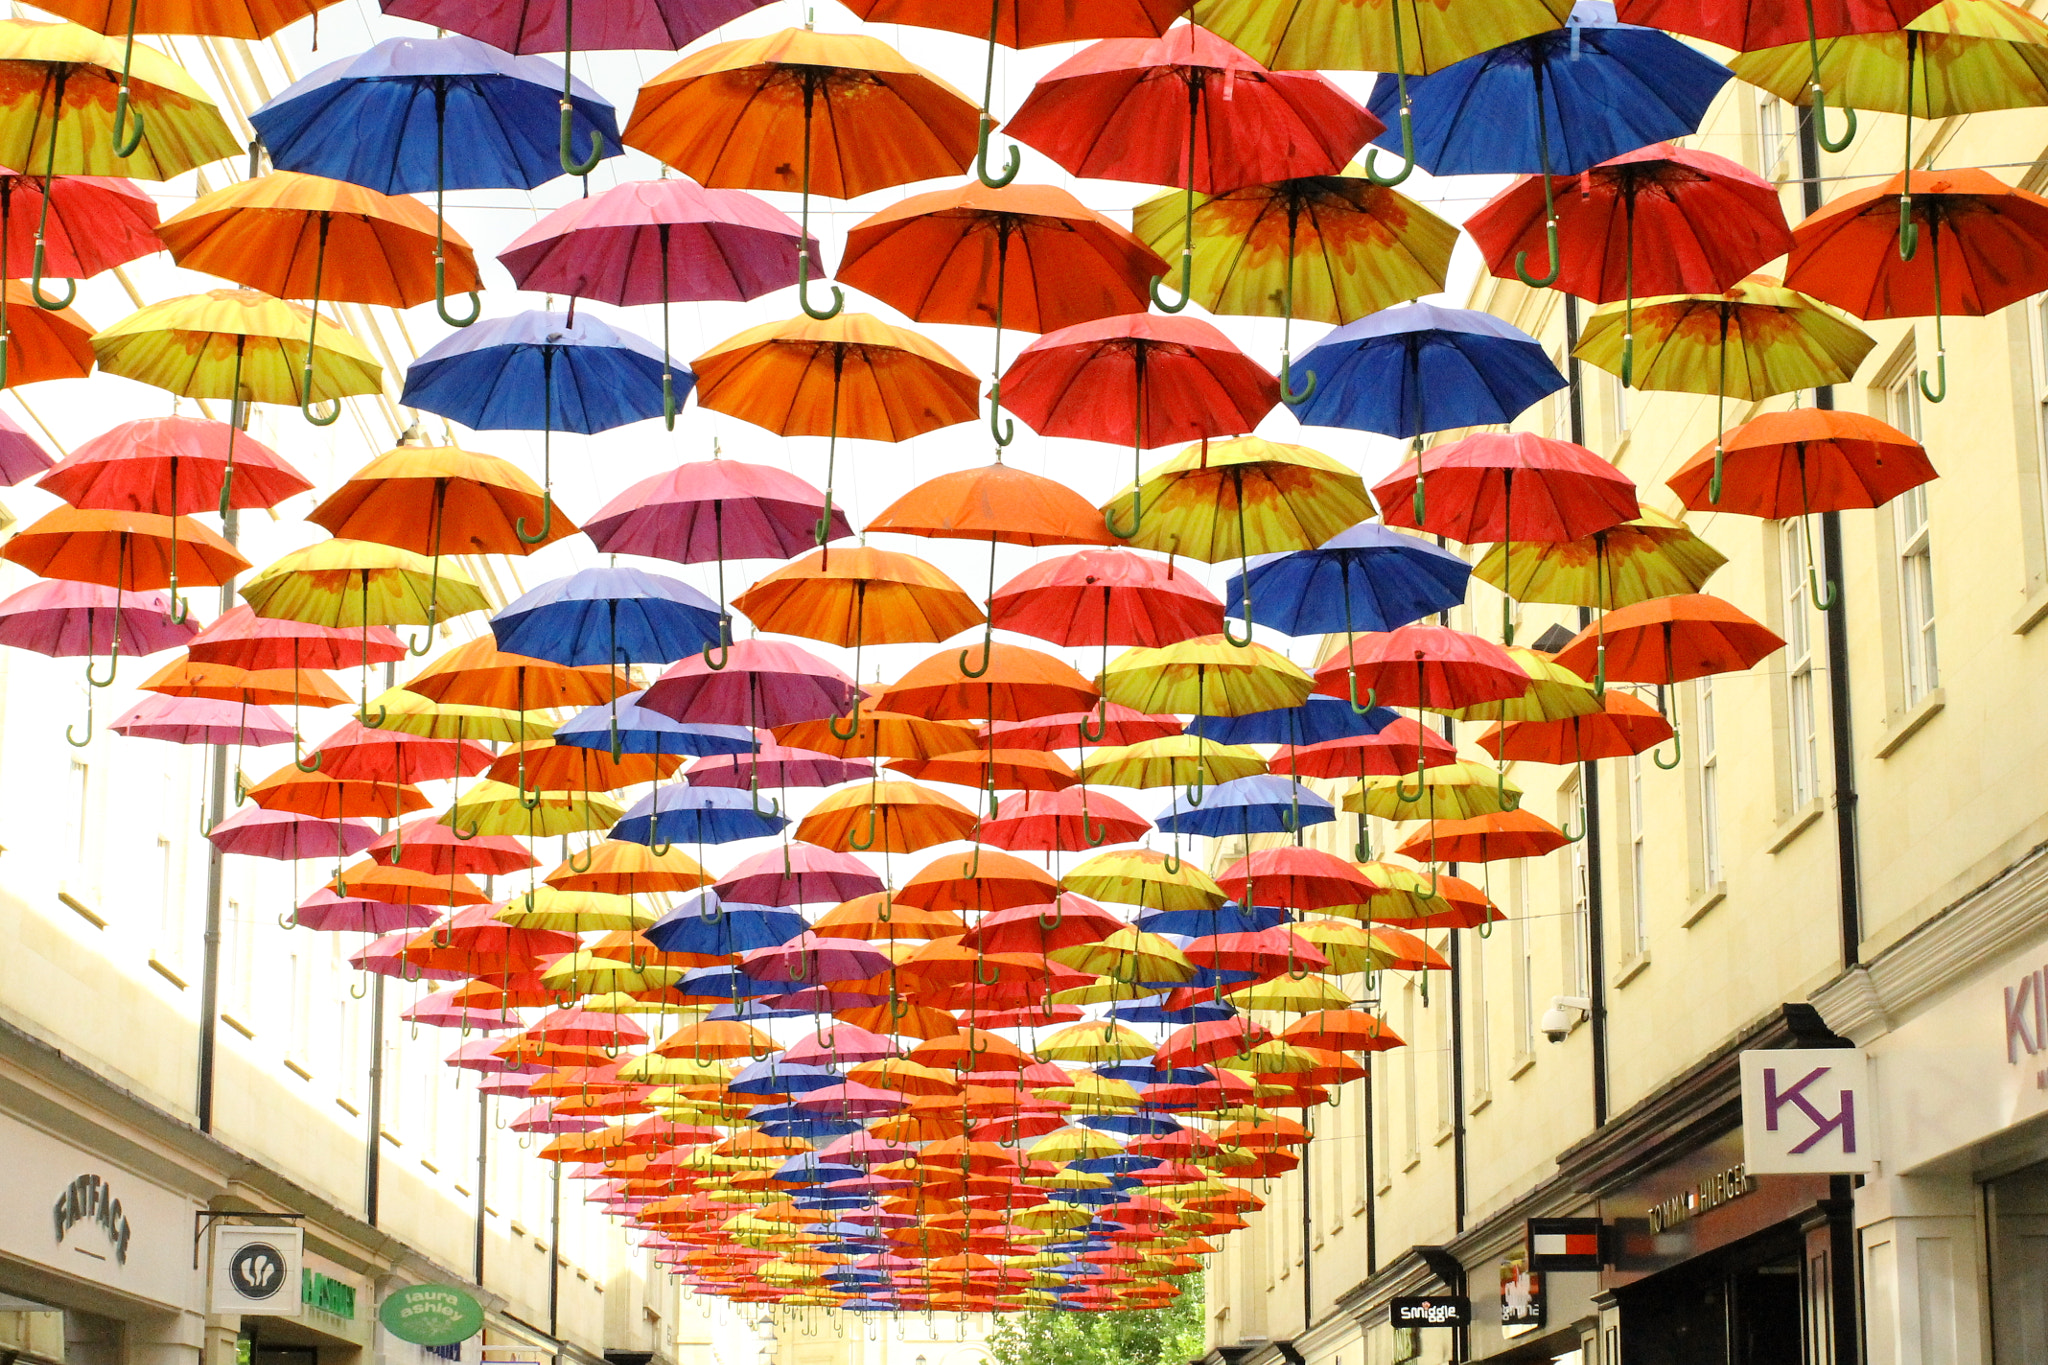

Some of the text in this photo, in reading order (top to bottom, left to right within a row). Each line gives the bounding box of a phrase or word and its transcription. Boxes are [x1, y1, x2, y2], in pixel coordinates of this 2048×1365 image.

[2004, 964, 2048, 1065] KI
[1648, 1162, 1748, 1236] TOMMY HILFIGER
[401, 1302, 464, 1322] ashley
[405, 1291, 458, 1306] laura
